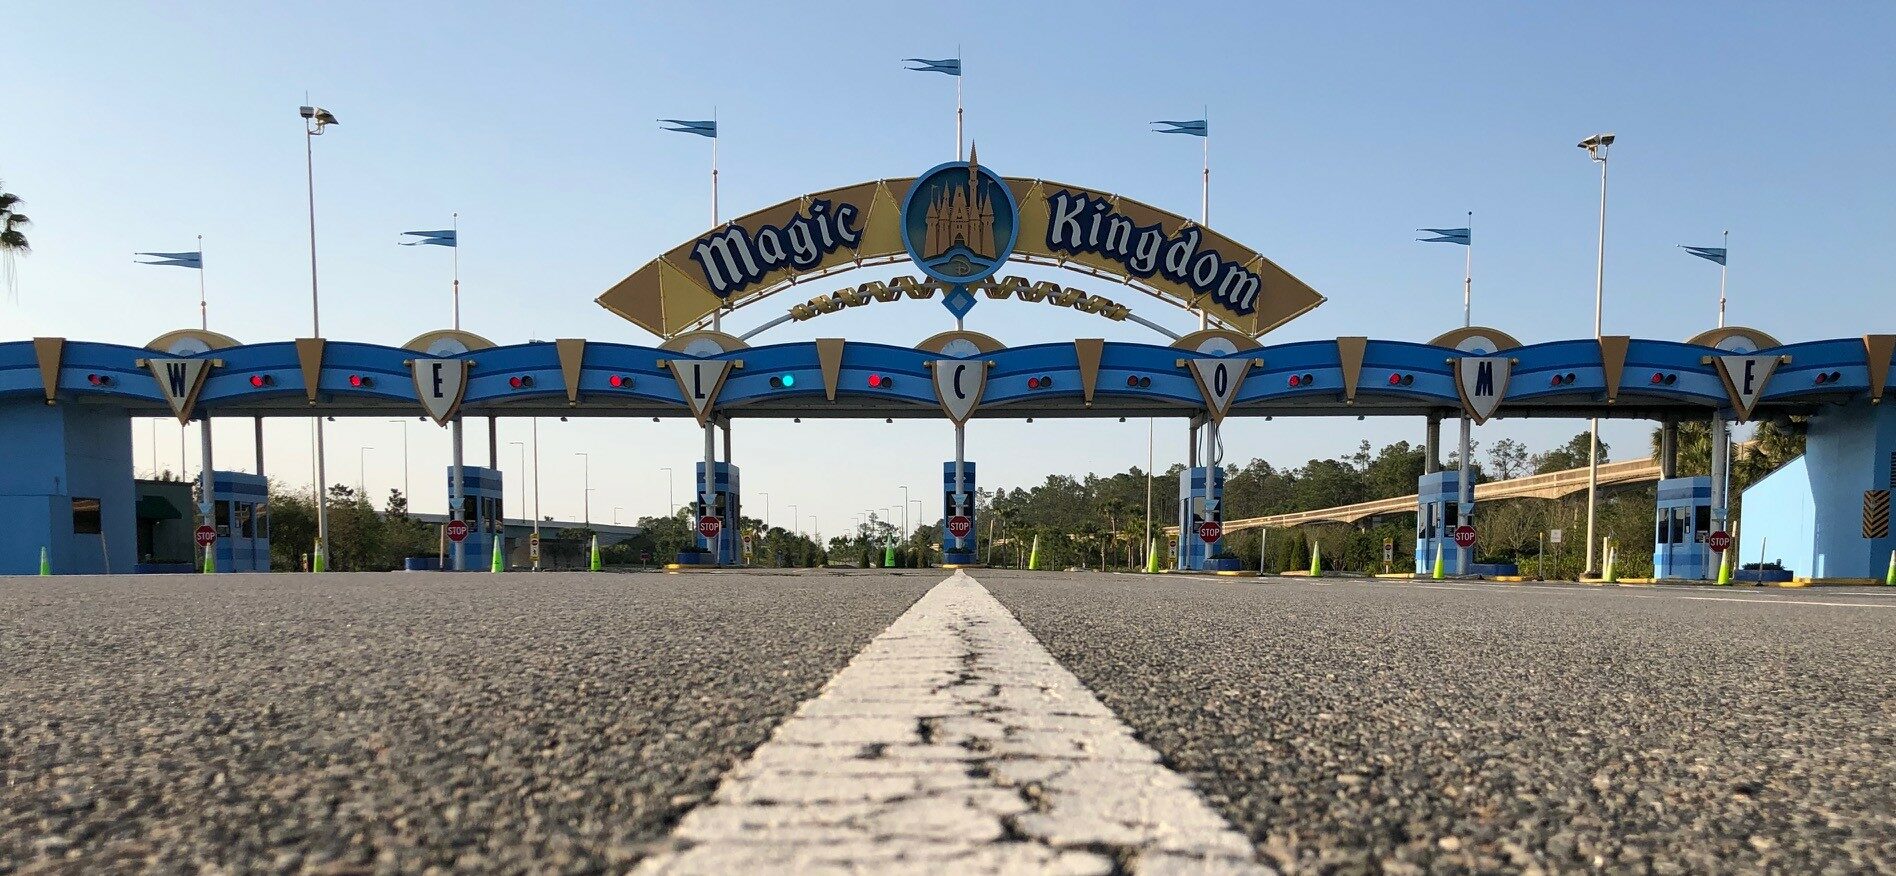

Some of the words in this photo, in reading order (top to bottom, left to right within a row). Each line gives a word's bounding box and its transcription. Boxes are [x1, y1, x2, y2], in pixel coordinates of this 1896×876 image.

[695, 202, 859, 293] Magic
[1049, 193, 1260, 312] Kingdom
[448, 526, 467, 536] STOP
[700, 522, 719, 531] STOP
[950, 522, 969, 531] STOP
[197, 532, 215, 541] STOP
[1201, 528, 1220, 537] STOP
[1455, 532, 1475, 541] STOP
[1710, 537, 1730, 546] STOP
